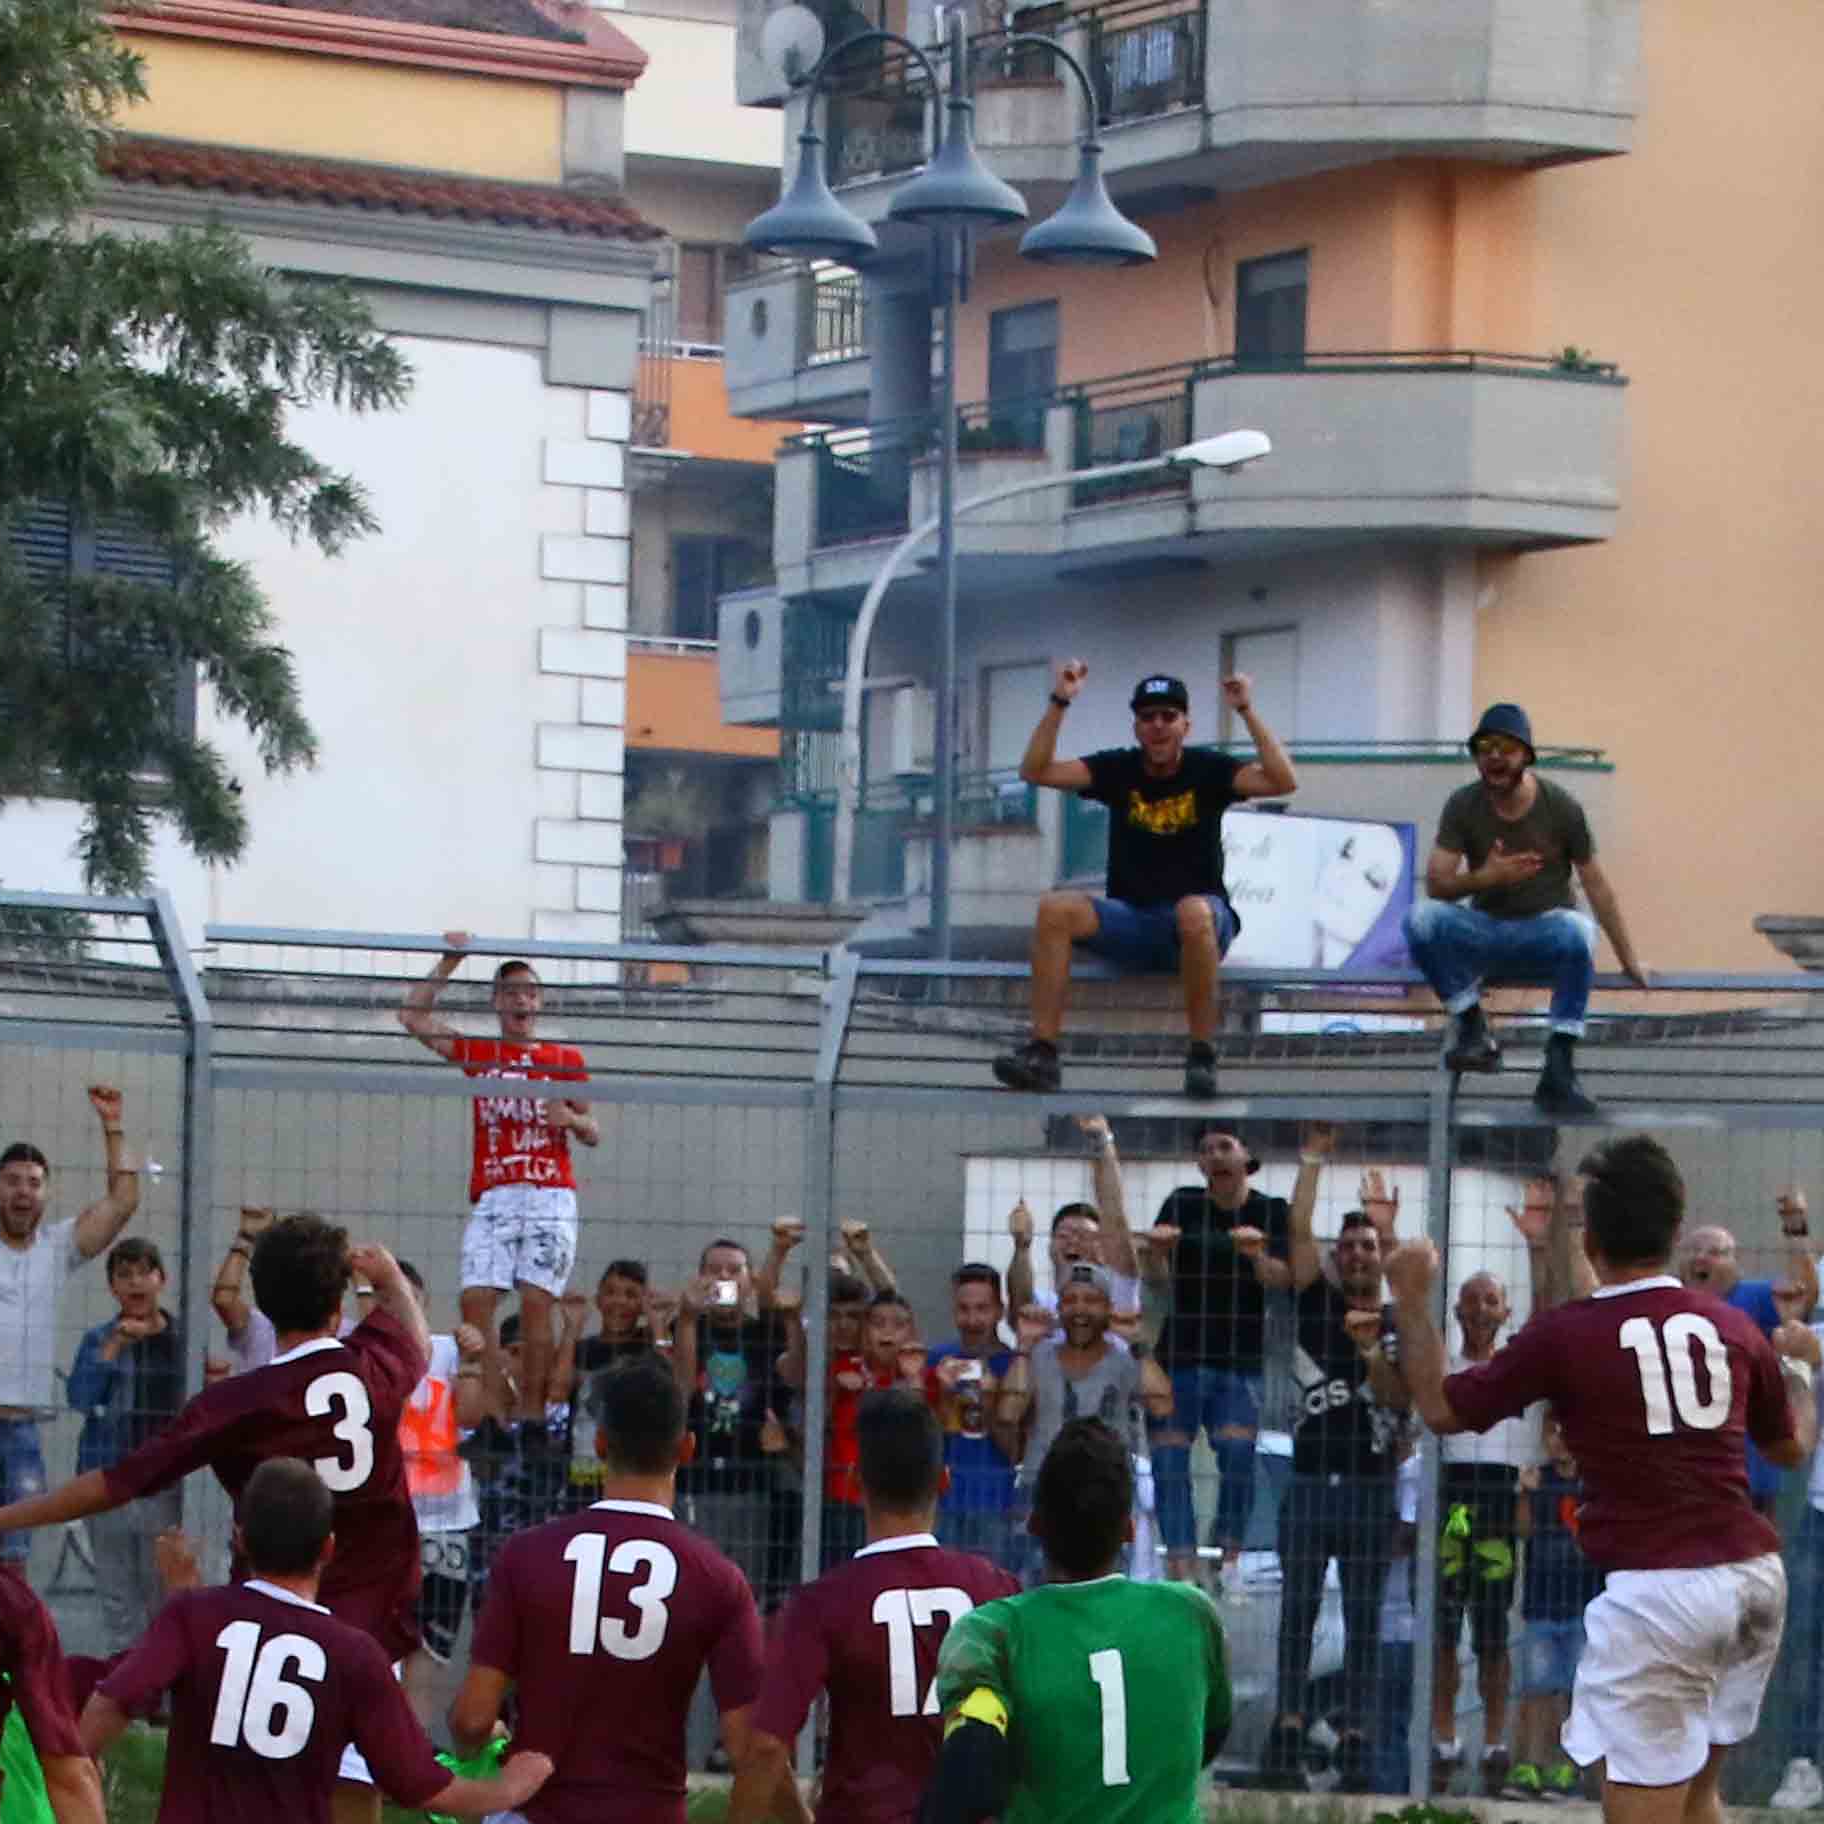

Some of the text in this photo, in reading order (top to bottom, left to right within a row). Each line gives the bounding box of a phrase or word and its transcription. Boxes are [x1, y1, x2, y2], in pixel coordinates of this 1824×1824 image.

[305, 1371, 375, 1492] 3
[1619, 1312, 1732, 1436] 10
[563, 1532, 678, 1661] 13
[872, 1587, 976, 1717] 17
[210, 1620, 327, 1759] 16
[1088, 1648, 1131, 1786] 1
